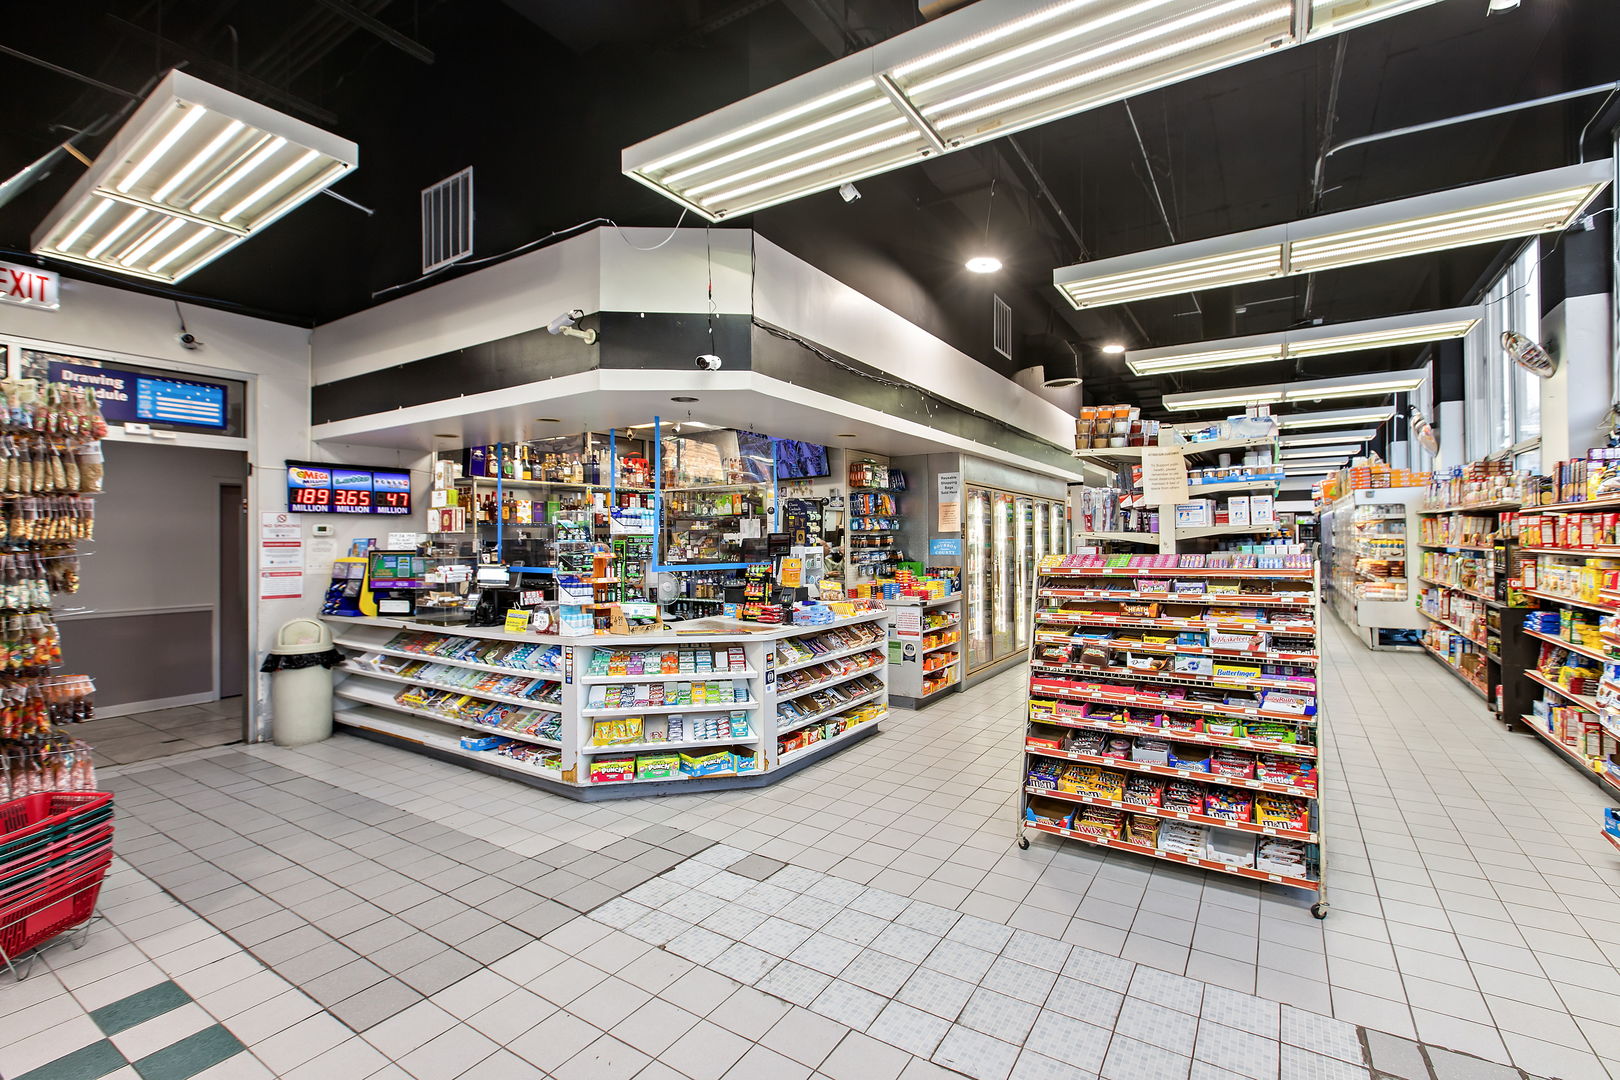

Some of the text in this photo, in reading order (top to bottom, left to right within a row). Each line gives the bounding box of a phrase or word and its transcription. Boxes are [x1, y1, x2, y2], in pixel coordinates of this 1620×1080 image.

[61, 369, 125, 390] Drawing
[303, 471, 328, 480] MEGA
[297, 489, 329, 505] 189
[386, 493, 409, 507] 47
[292, 503, 329, 513] MILLION
[337, 504, 371, 514] MILLION
[377, 506, 409, 515] MILLION
[1129, 605, 1147, 613] HEATH
[1215, 634, 1250, 644] Musketeers
[1217, 668, 1256, 678] Butterfinger
[648, 762, 671, 772] PUNCH
[703, 758, 722, 768] PUNCH
[601, 766, 625, 775] PUNCH
[1220, 768, 1244, 778] Mounds
[1261, 776, 1295, 785] Skittles
